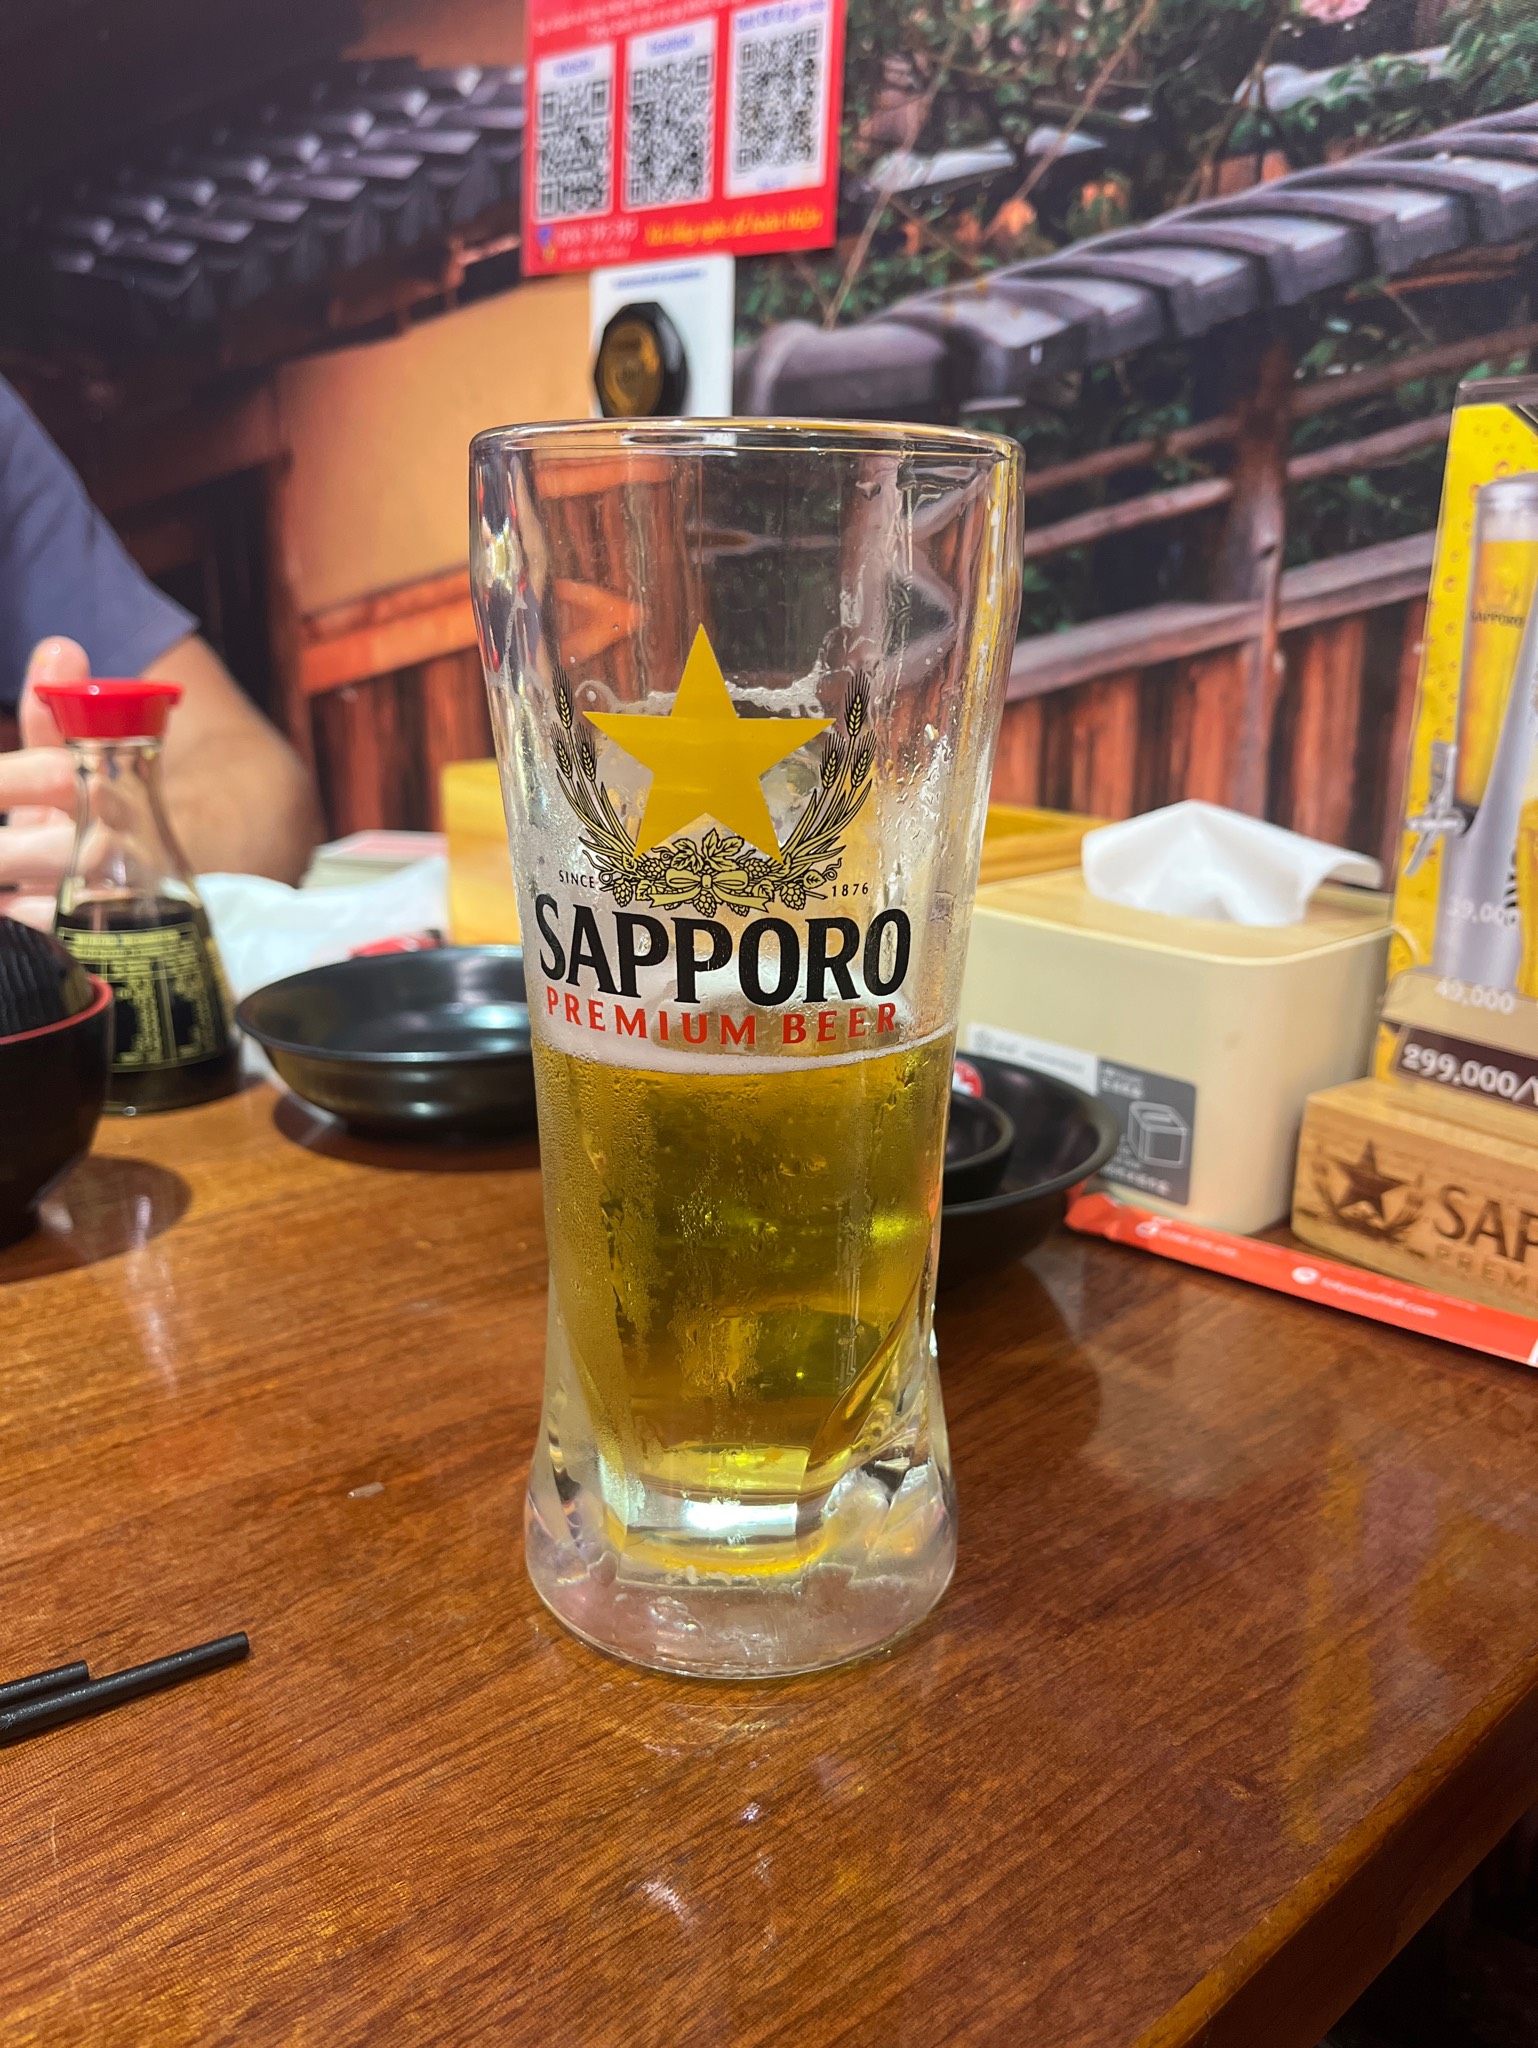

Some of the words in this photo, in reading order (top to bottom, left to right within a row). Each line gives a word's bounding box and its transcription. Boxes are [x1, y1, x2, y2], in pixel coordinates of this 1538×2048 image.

[558, 869, 595, 889] SINCE
[831, 883, 870, 897] 1876
[535, 893, 911, 1006] SAPPORO
[546, 985, 756, 1045] PREMIUM
[782, 1002, 896, 1045] BEER
